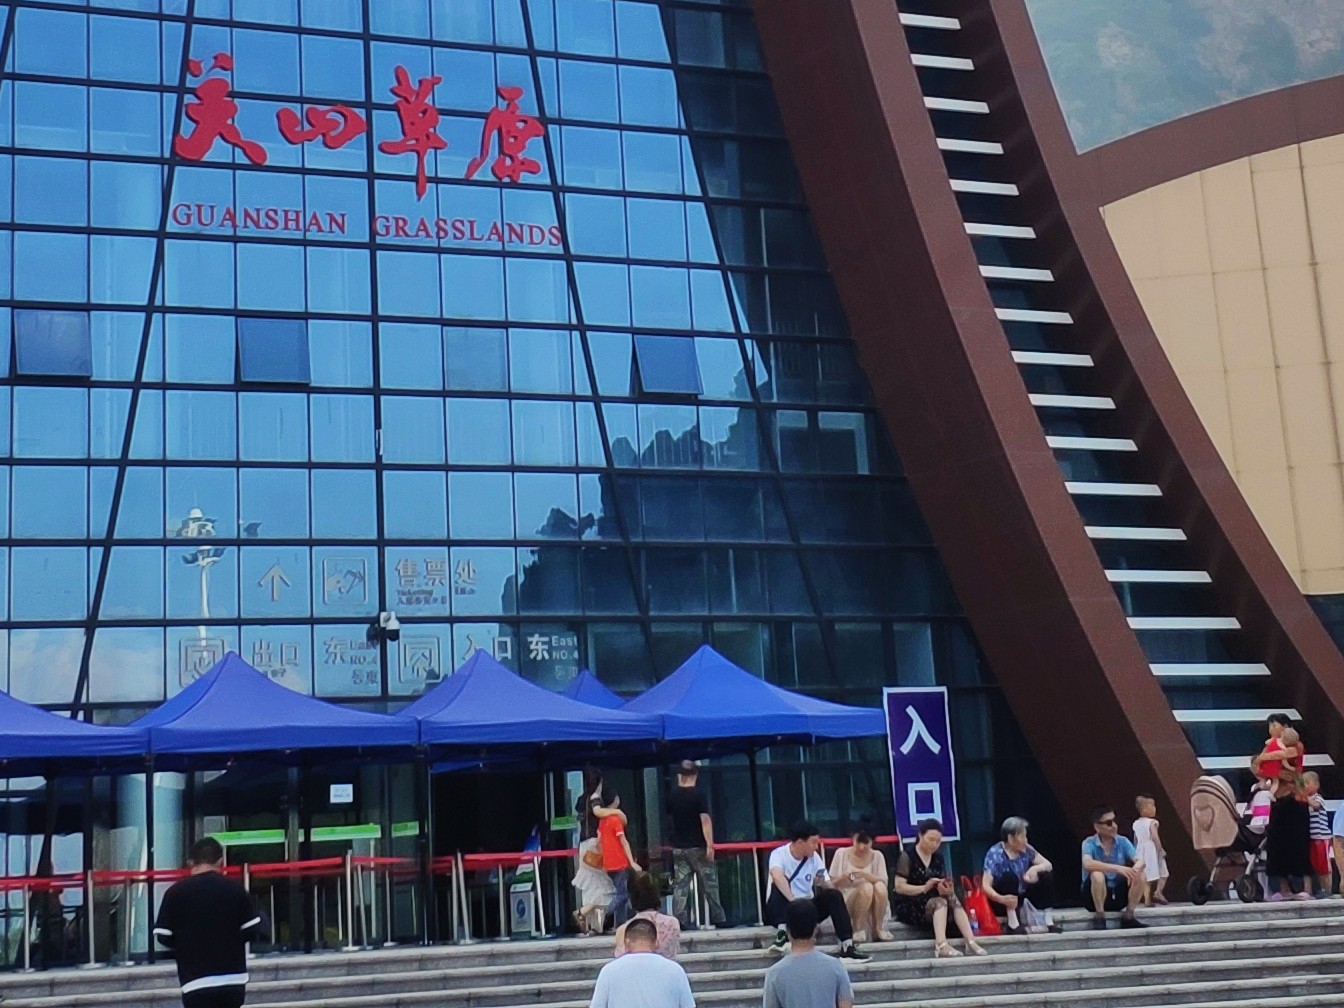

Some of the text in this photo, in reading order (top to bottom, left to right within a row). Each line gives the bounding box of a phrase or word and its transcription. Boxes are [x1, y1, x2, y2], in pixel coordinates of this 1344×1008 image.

[173, 52, 545, 201] 关山草原
[172, 204, 562, 247] GUANSHAN GRASSLANDS
[395, 558, 478, 587] 售票处
[252, 639, 299, 668] 出口
[527, 633, 550, 661] 东
[899, 704, 943, 826] 入口
